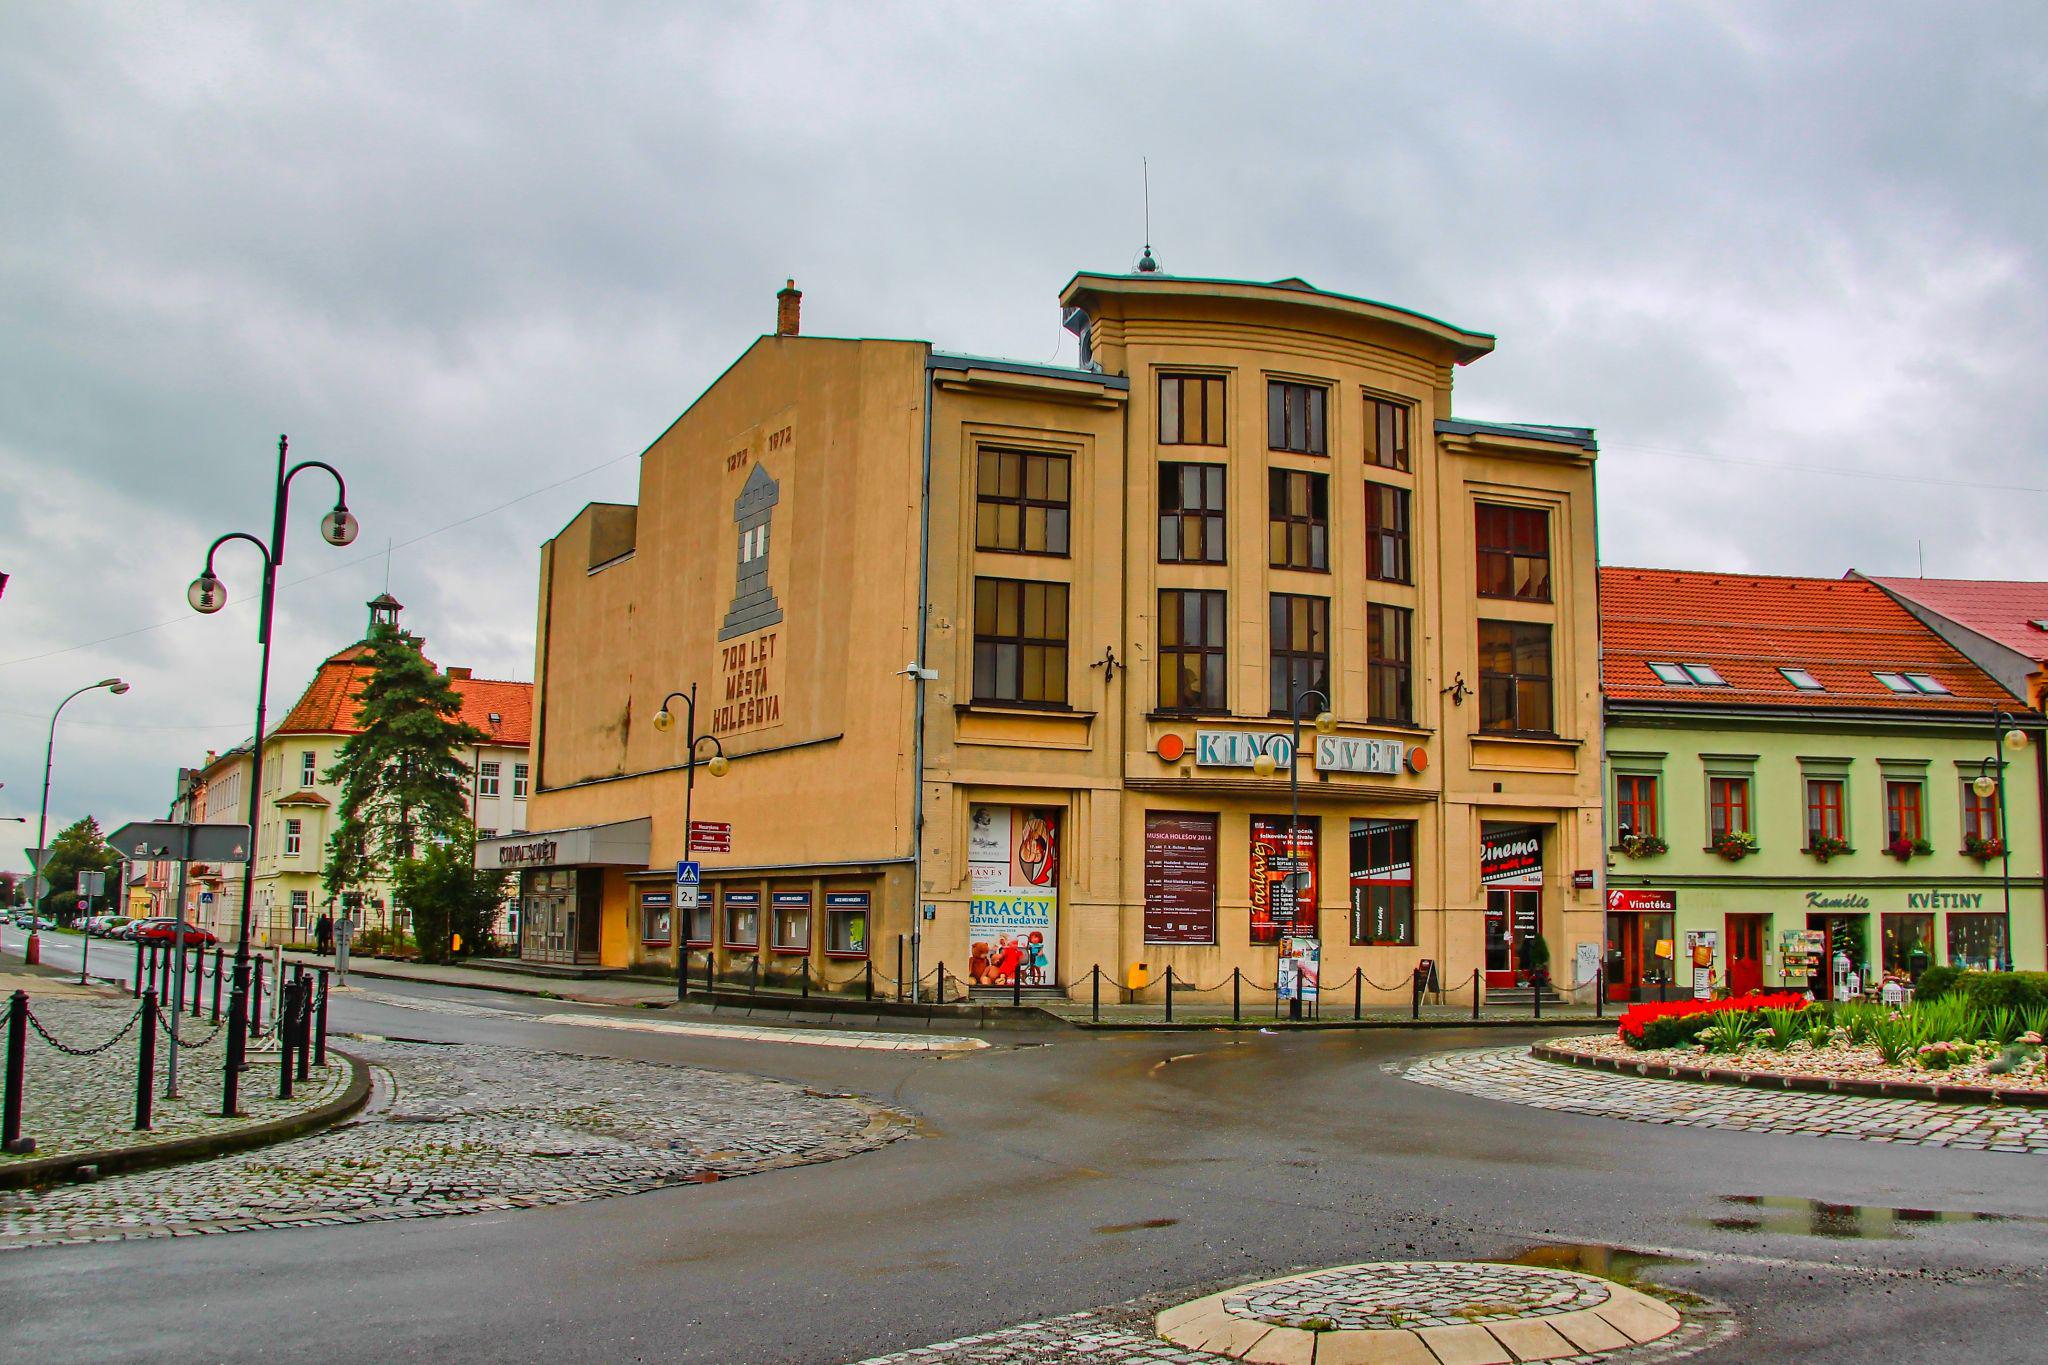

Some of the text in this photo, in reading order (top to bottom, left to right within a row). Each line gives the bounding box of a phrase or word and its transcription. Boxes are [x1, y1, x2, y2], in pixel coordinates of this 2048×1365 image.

[727, 426, 792, 472] 1272 1972
[722, 634, 776, 672] 700 LET
[726, 667, 768, 700] MĚSTA
[712, 695, 780, 733] HOLEŠOVA
[1200, 734, 1399, 773] KINO SVĚT
[970, 898, 1048, 916] HRAČKY
[1629, 900, 1672, 909] Vinotéka
[1805, 888, 1982, 908] Kamélie KVĚTINY
[970, 914, 998, 924] dávné
[1008, 915, 1048, 924] nedávné
